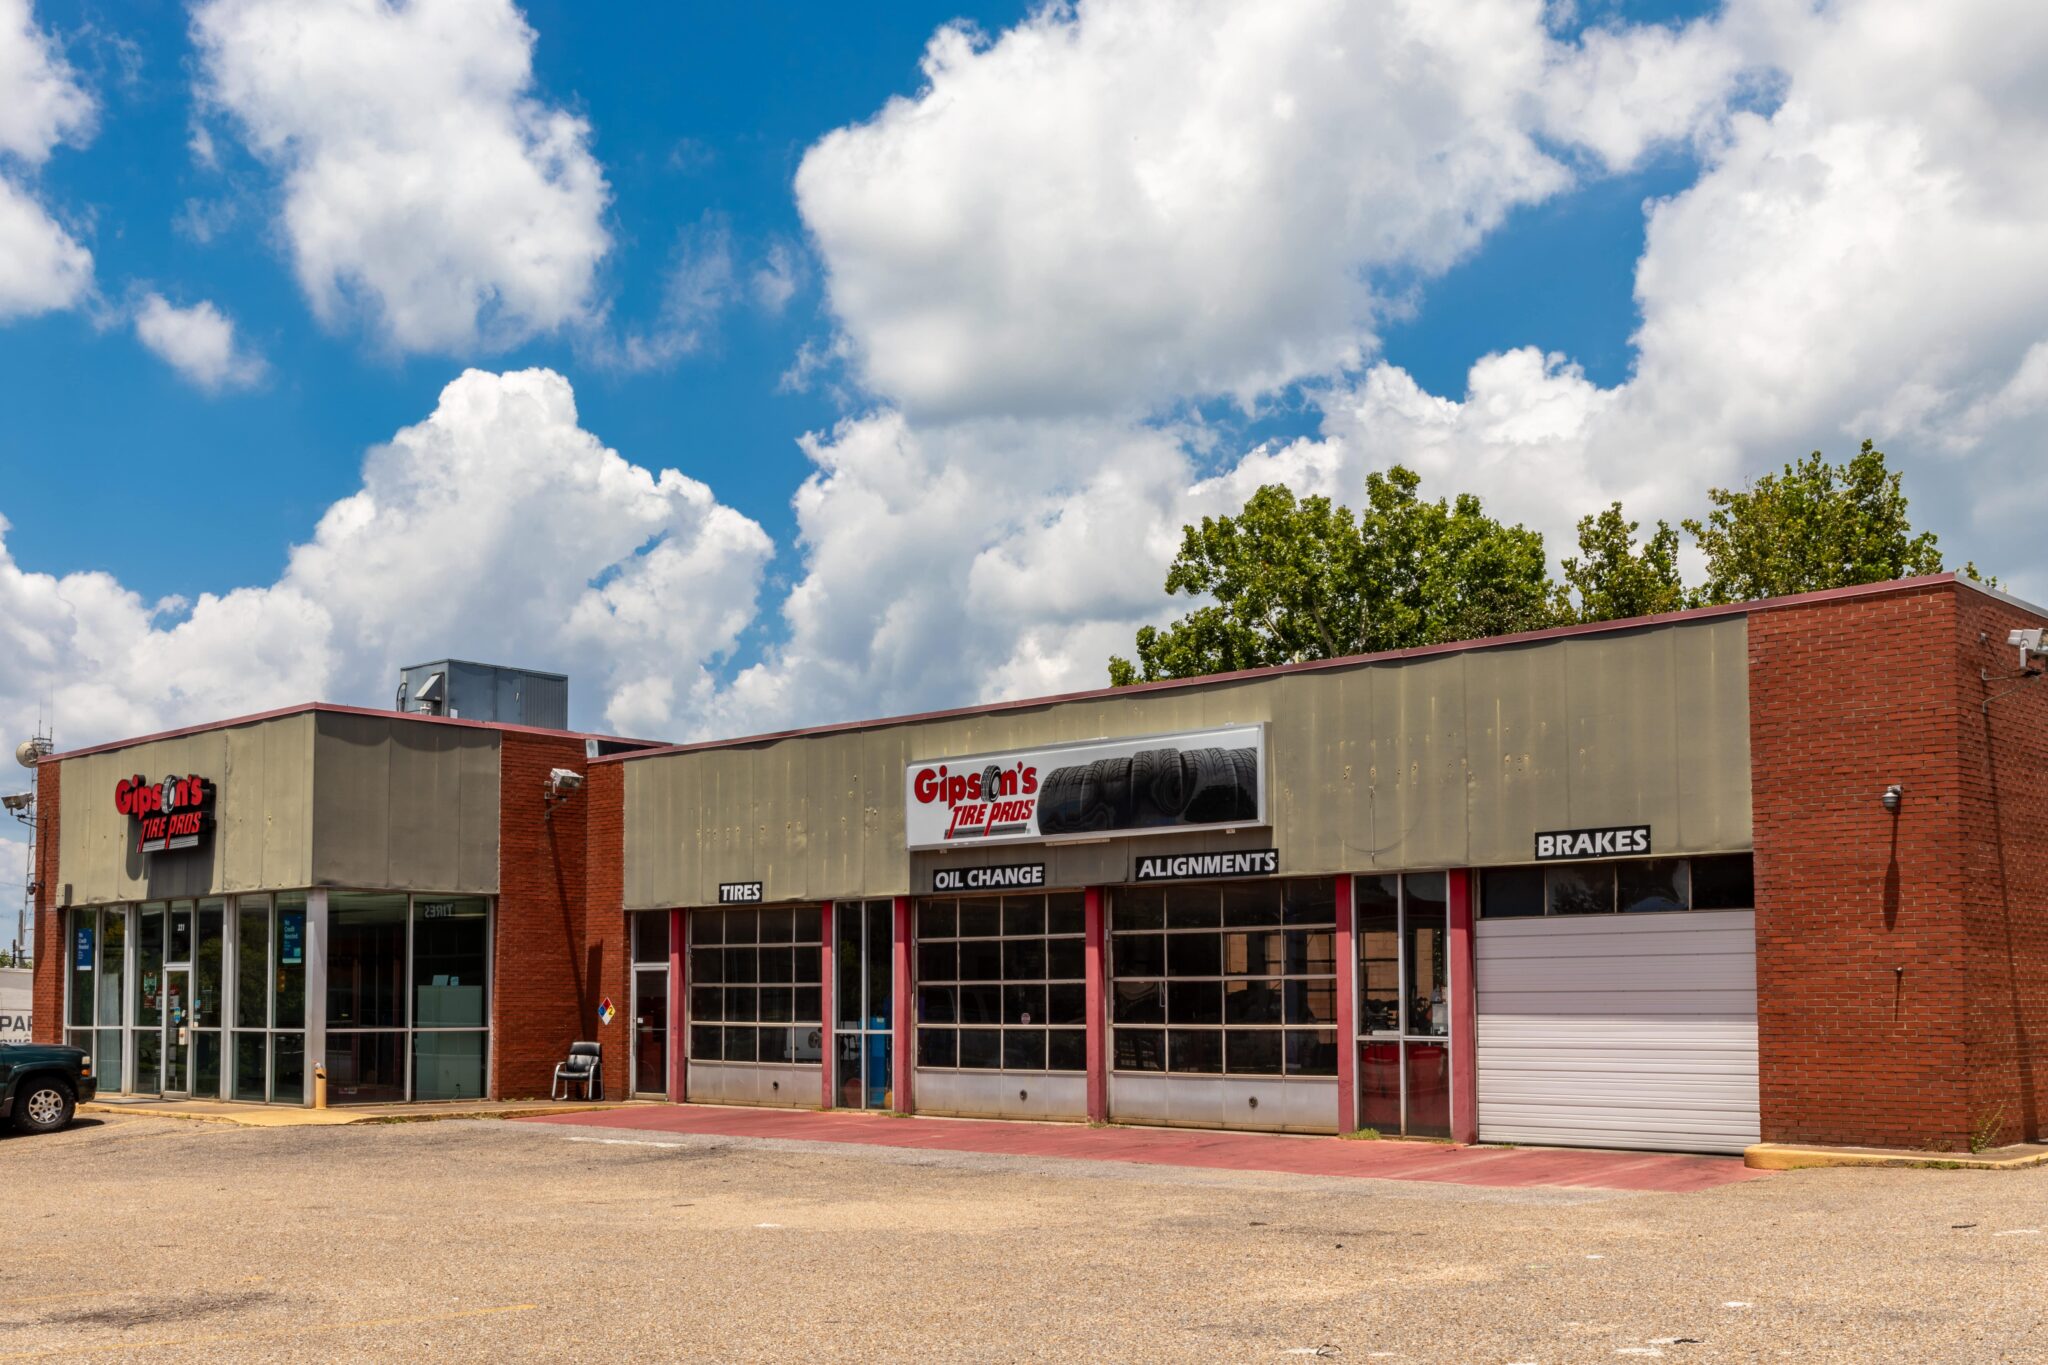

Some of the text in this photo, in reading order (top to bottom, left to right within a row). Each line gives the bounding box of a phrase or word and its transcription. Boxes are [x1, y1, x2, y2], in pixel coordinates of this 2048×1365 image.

[115, 774, 203, 820] Gipson's
[914, 761, 1038, 810] Gipson's
[137, 812, 202, 854] TIRE PROS
[947, 799, 1035, 840] TIRE PROS
[1538, 829, 1647, 857] BRAKES
[935, 866, 1043, 889] OIL CHANGE
[1138, 852, 1276, 878] ALIGNMENTS
[721, 884, 760, 901] TIRES
